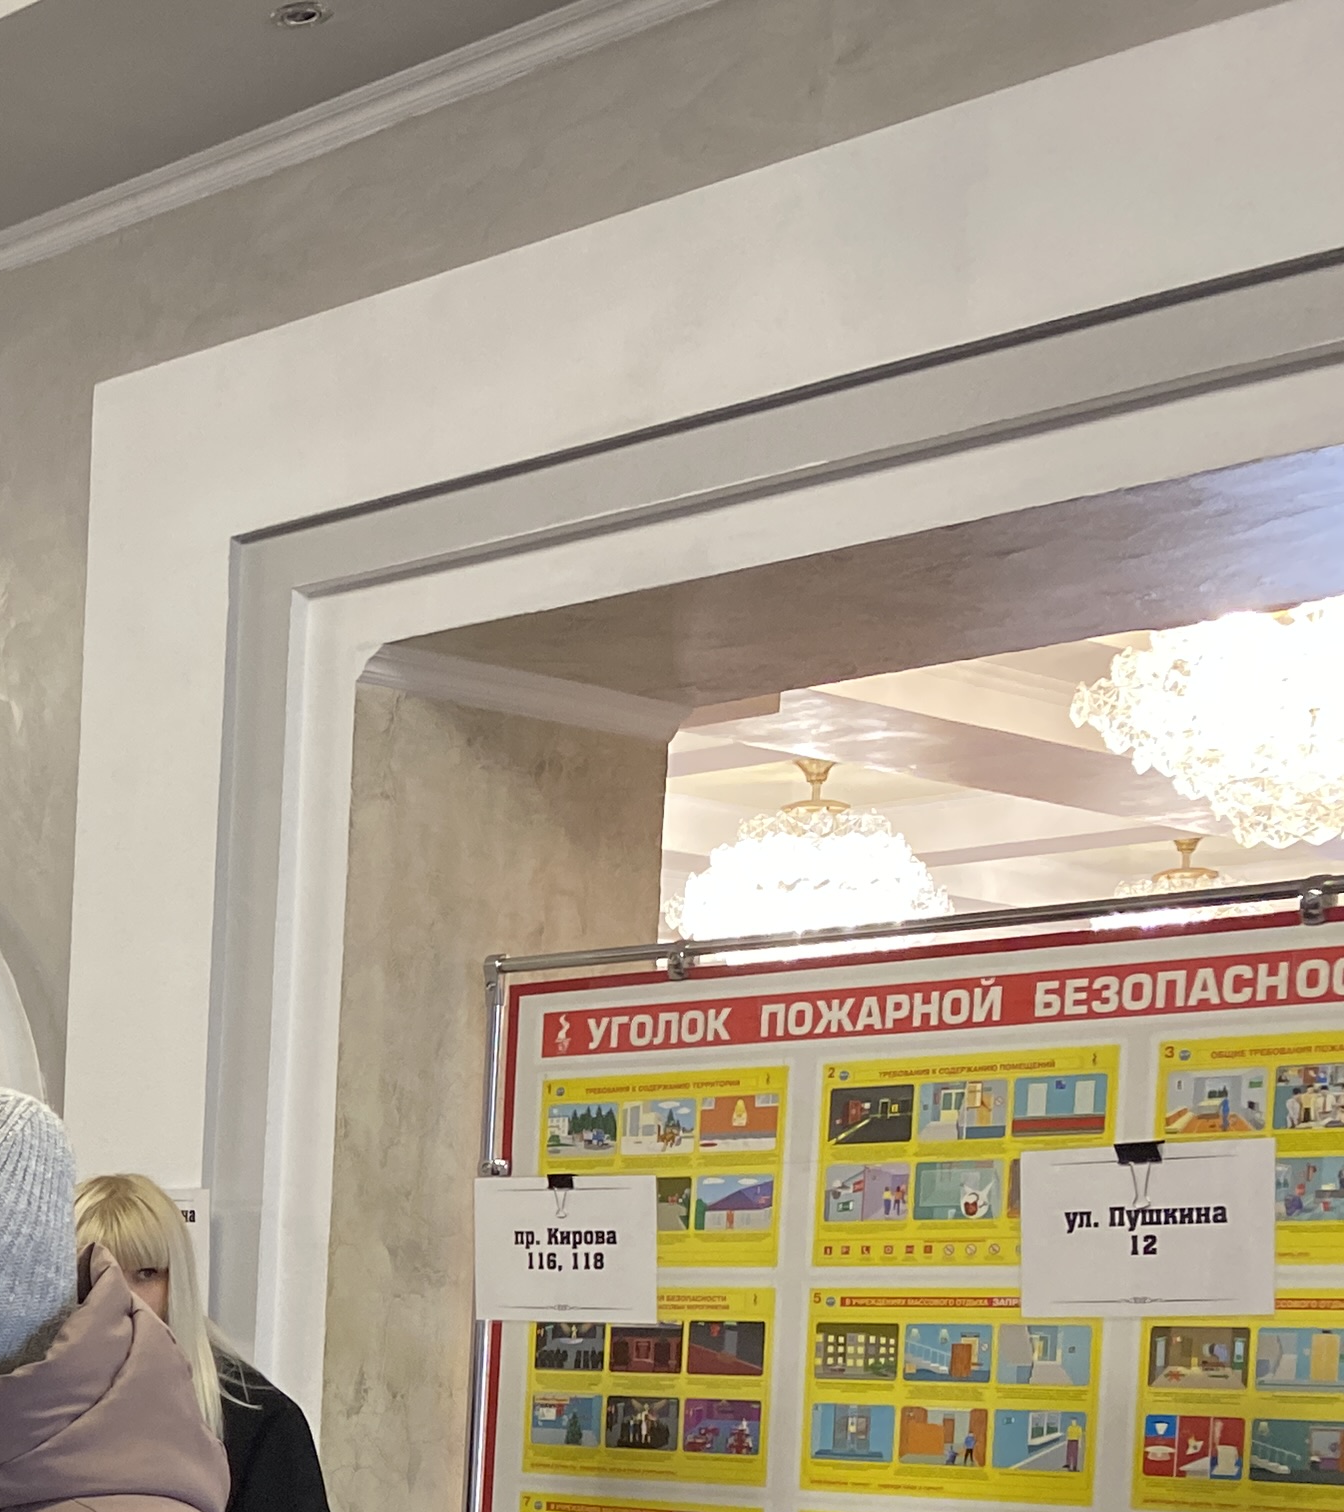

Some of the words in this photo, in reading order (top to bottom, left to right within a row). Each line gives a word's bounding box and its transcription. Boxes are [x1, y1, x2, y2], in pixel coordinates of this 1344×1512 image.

[587, 1007, 732, 1050] УГОЛОК
[760, 977, 1003, 1038] ПОЖАРНОЙ
[1164, 1046, 1174, 1058] 3
[828, 1068, 835, 1078] 2
[1064, 1210, 1099, 1234] ул.
[1108, 1204, 1228, 1232] Пушкина
[514, 1230, 541, 1249] пр.
[547, 1227, 618, 1249] Кирова
[1130, 1234, 1157, 1255] 12
[527, 1252, 563, 1272] 116,
[572, 1252, 605, 1270] 118
[813, 1291, 822, 1304] 5
[523, 1496, 531, 1506] 7
